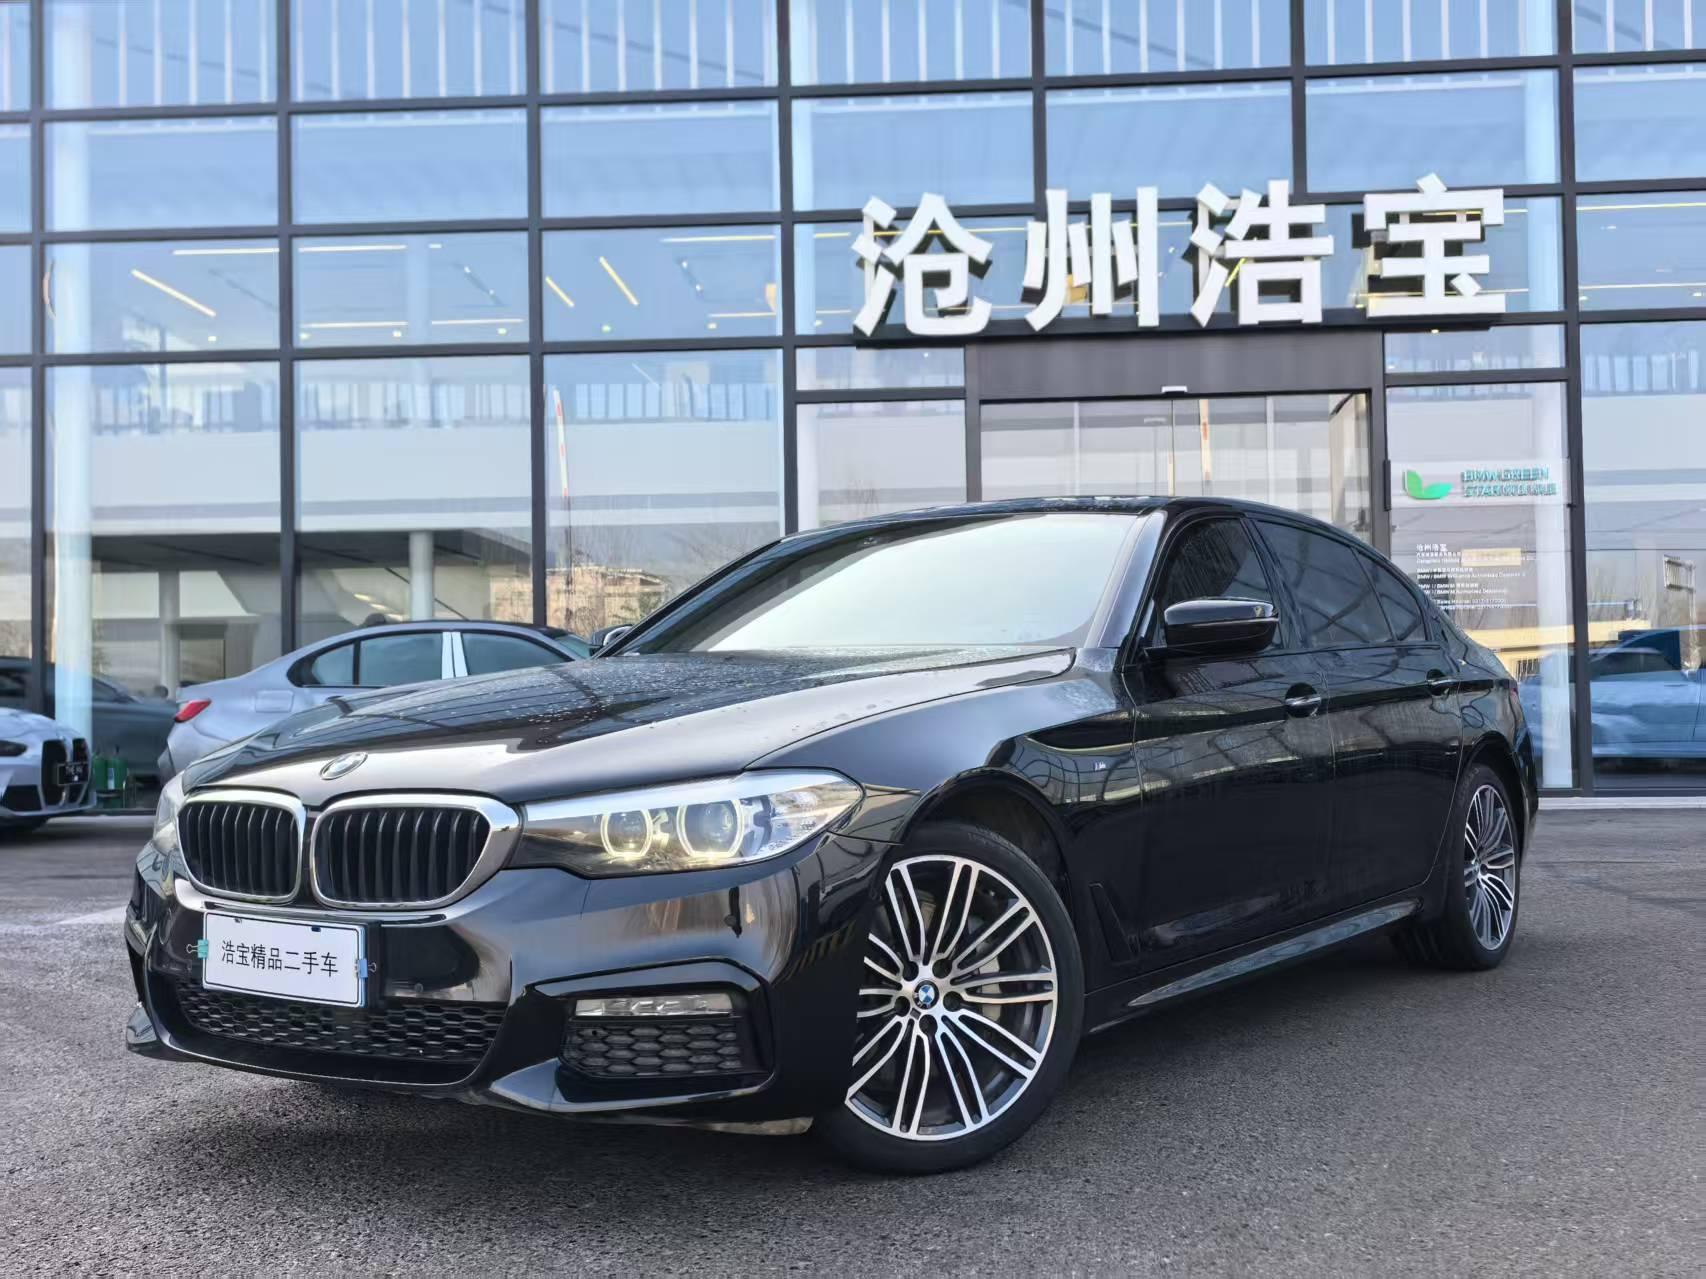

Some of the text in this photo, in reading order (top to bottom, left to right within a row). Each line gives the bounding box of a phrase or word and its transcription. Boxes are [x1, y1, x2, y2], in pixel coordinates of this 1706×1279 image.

[851, 173, 1506, 337] 沧州浩宝
[221, 940, 339, 978] 浩宝精品二手车
